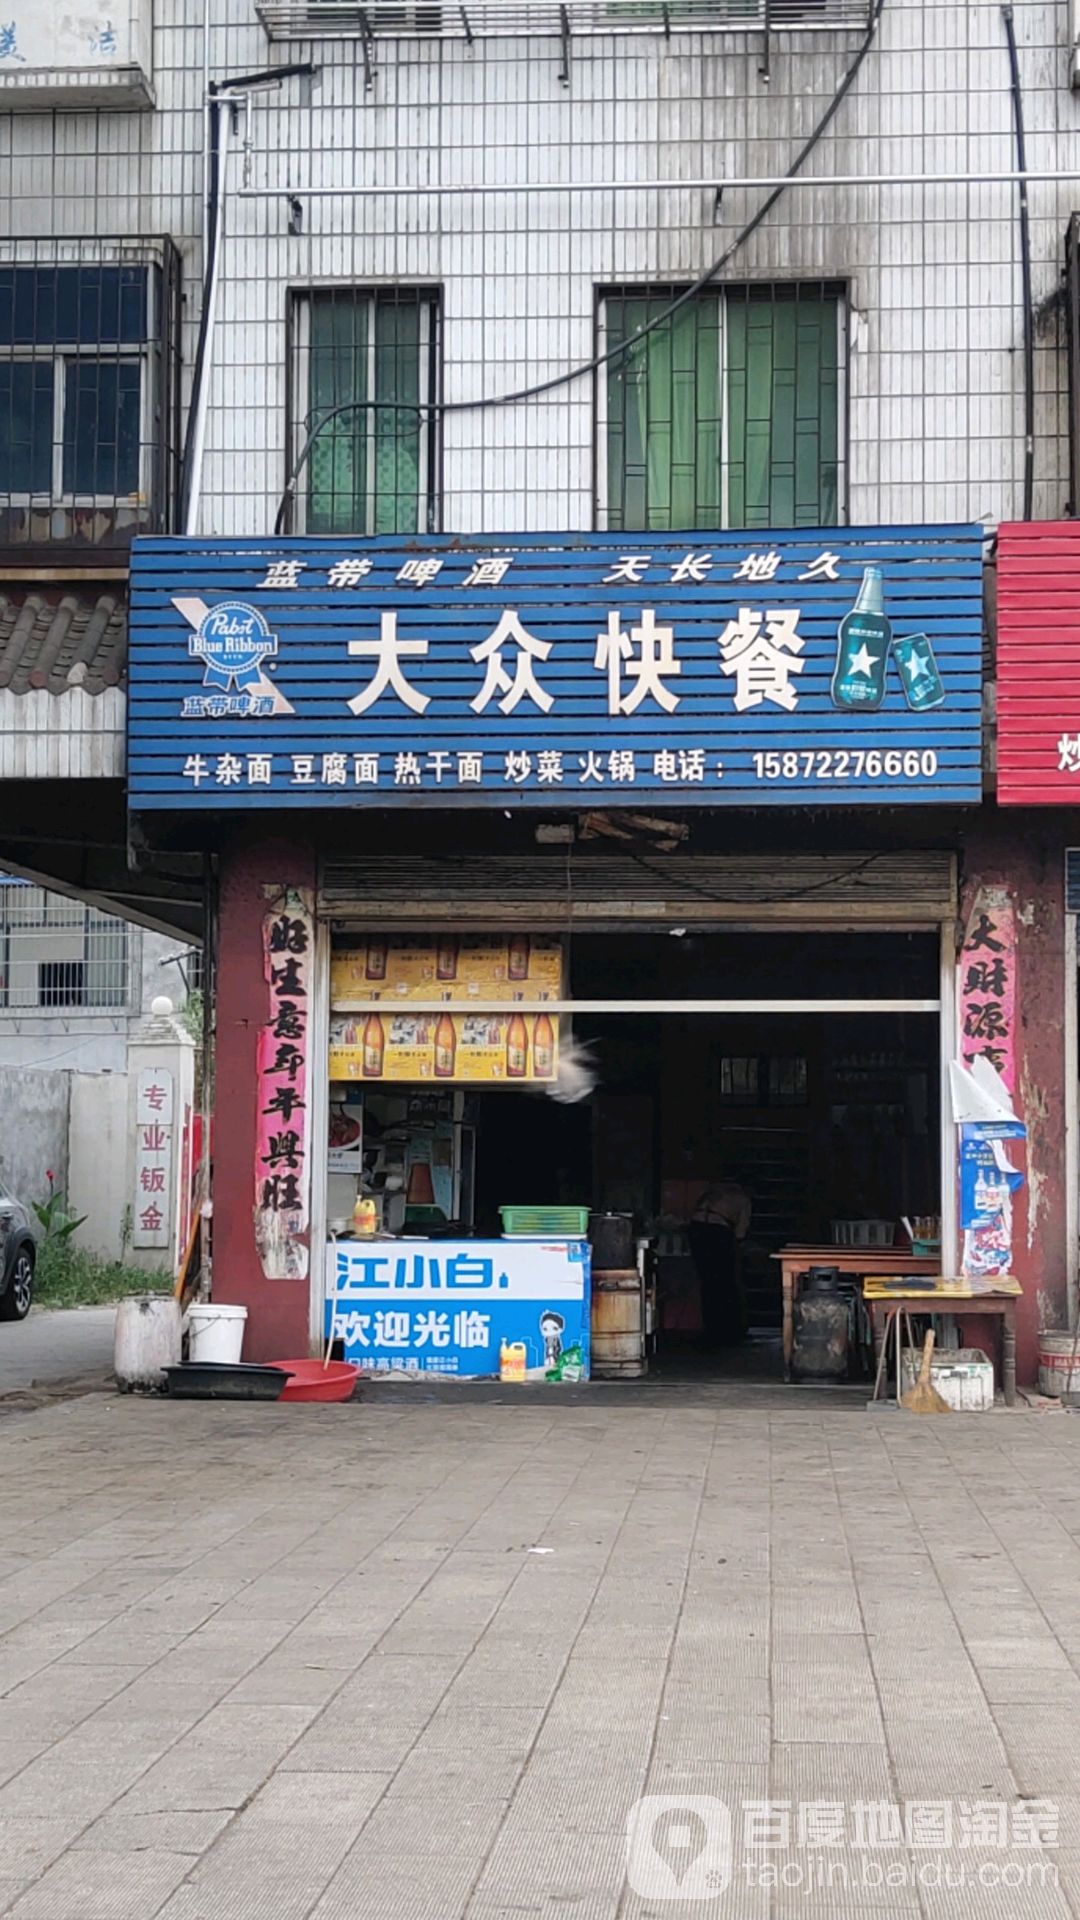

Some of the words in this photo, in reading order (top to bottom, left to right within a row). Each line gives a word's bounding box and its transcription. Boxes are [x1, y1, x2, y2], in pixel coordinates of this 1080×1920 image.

[256, 557, 514, 588] 蓝带啤酒
[602, 551, 840, 582] 天长地久
[211, 613, 254, 635] Pabst
[193, 637, 223, 653] Blue
[225, 637, 273, 653] Ribbon
[347, 608, 806, 716] 大众快餐
[181, 695, 276, 717] 蓝带啤酒
[183, 753, 273, 786] 牛杂面
[291, 752, 381, 785] 豆腐面
[394, 751, 484, 785] 热干面
[504, 750, 563, 783] 炒菜
[578, 750, 635, 782] 火锅
[753, 750, 938, 778] 15872276660
[140, 1085, 167, 1231] 专业钣金
[337, 1252, 493, 1290] 江小白
[333, 1310, 490, 1348] 欢迎光临
